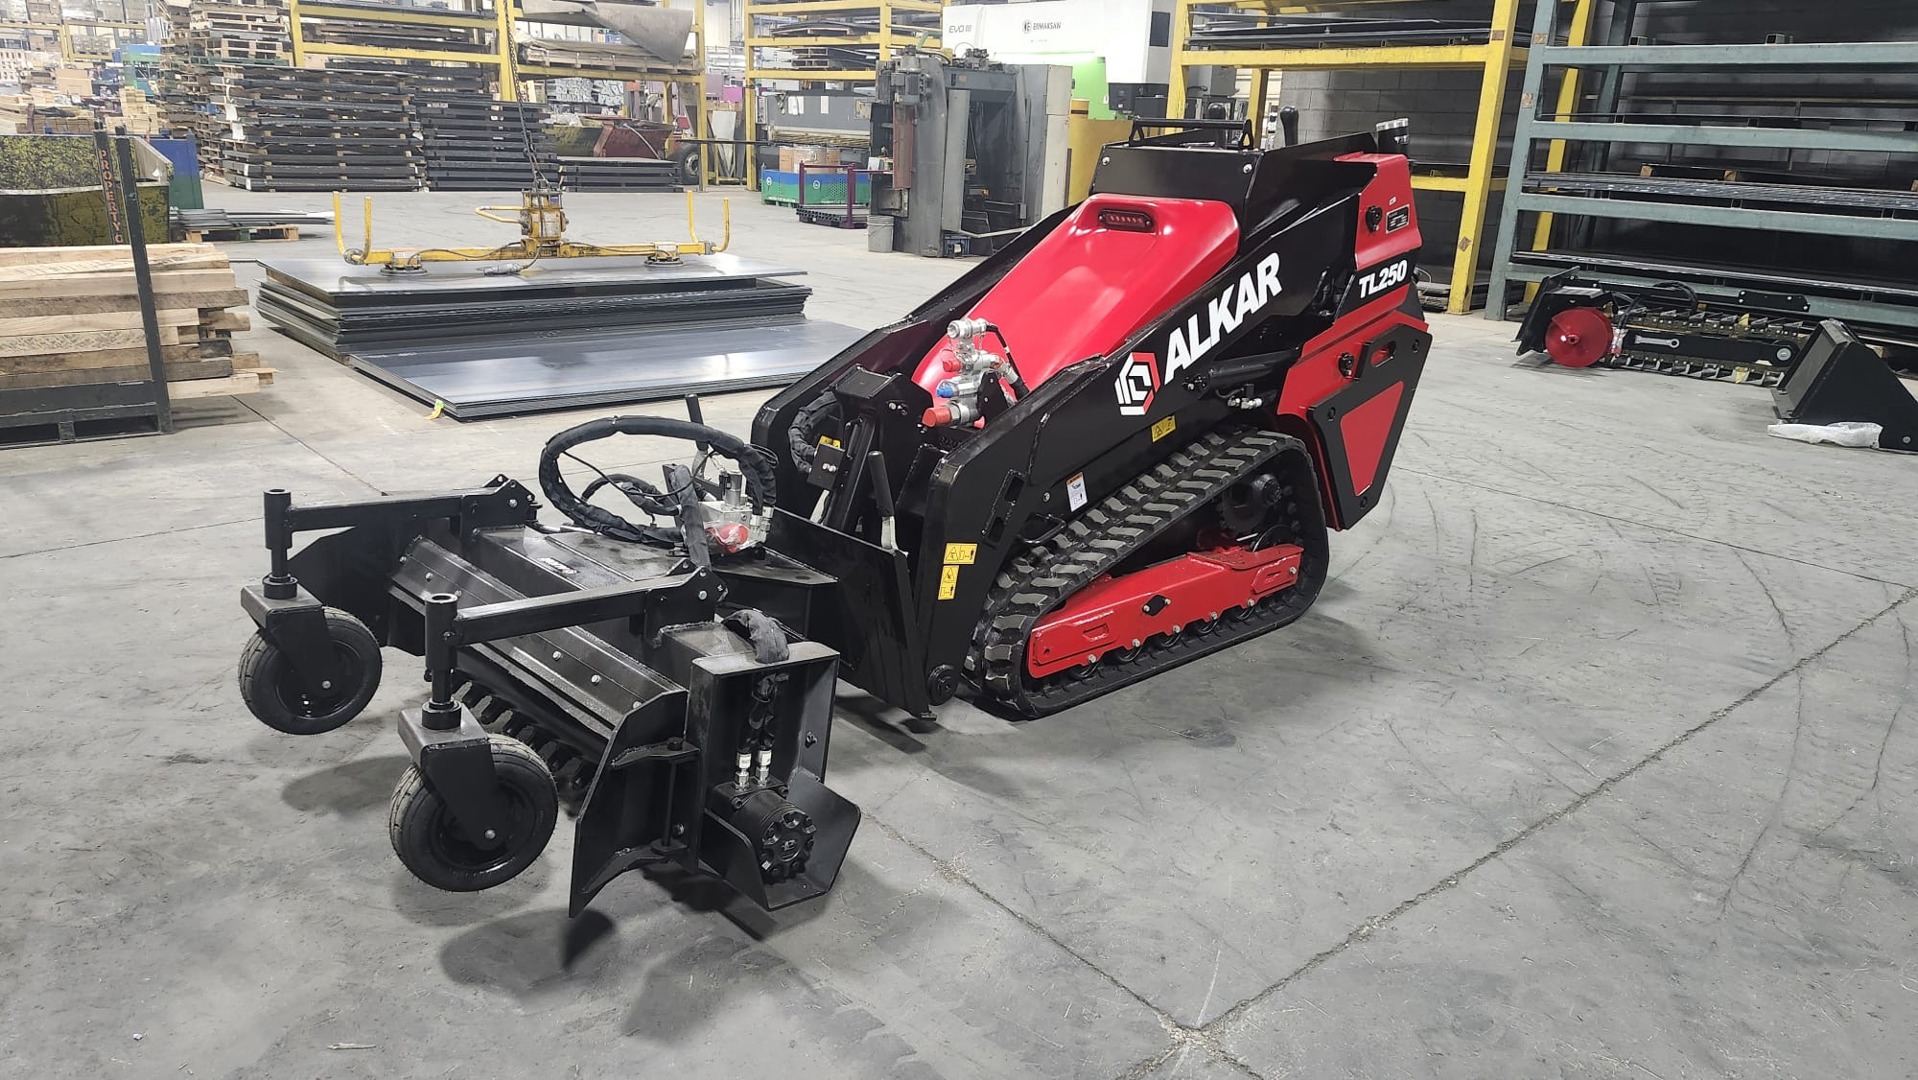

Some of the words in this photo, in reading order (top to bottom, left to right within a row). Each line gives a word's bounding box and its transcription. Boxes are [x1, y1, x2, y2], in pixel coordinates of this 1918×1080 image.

[949, 25, 964, 33] EVO
[98, 149, 121, 231] PROPERTY
[1359, 260, 1408, 298] TL250
[1164, 252, 1283, 386] ALKAR
